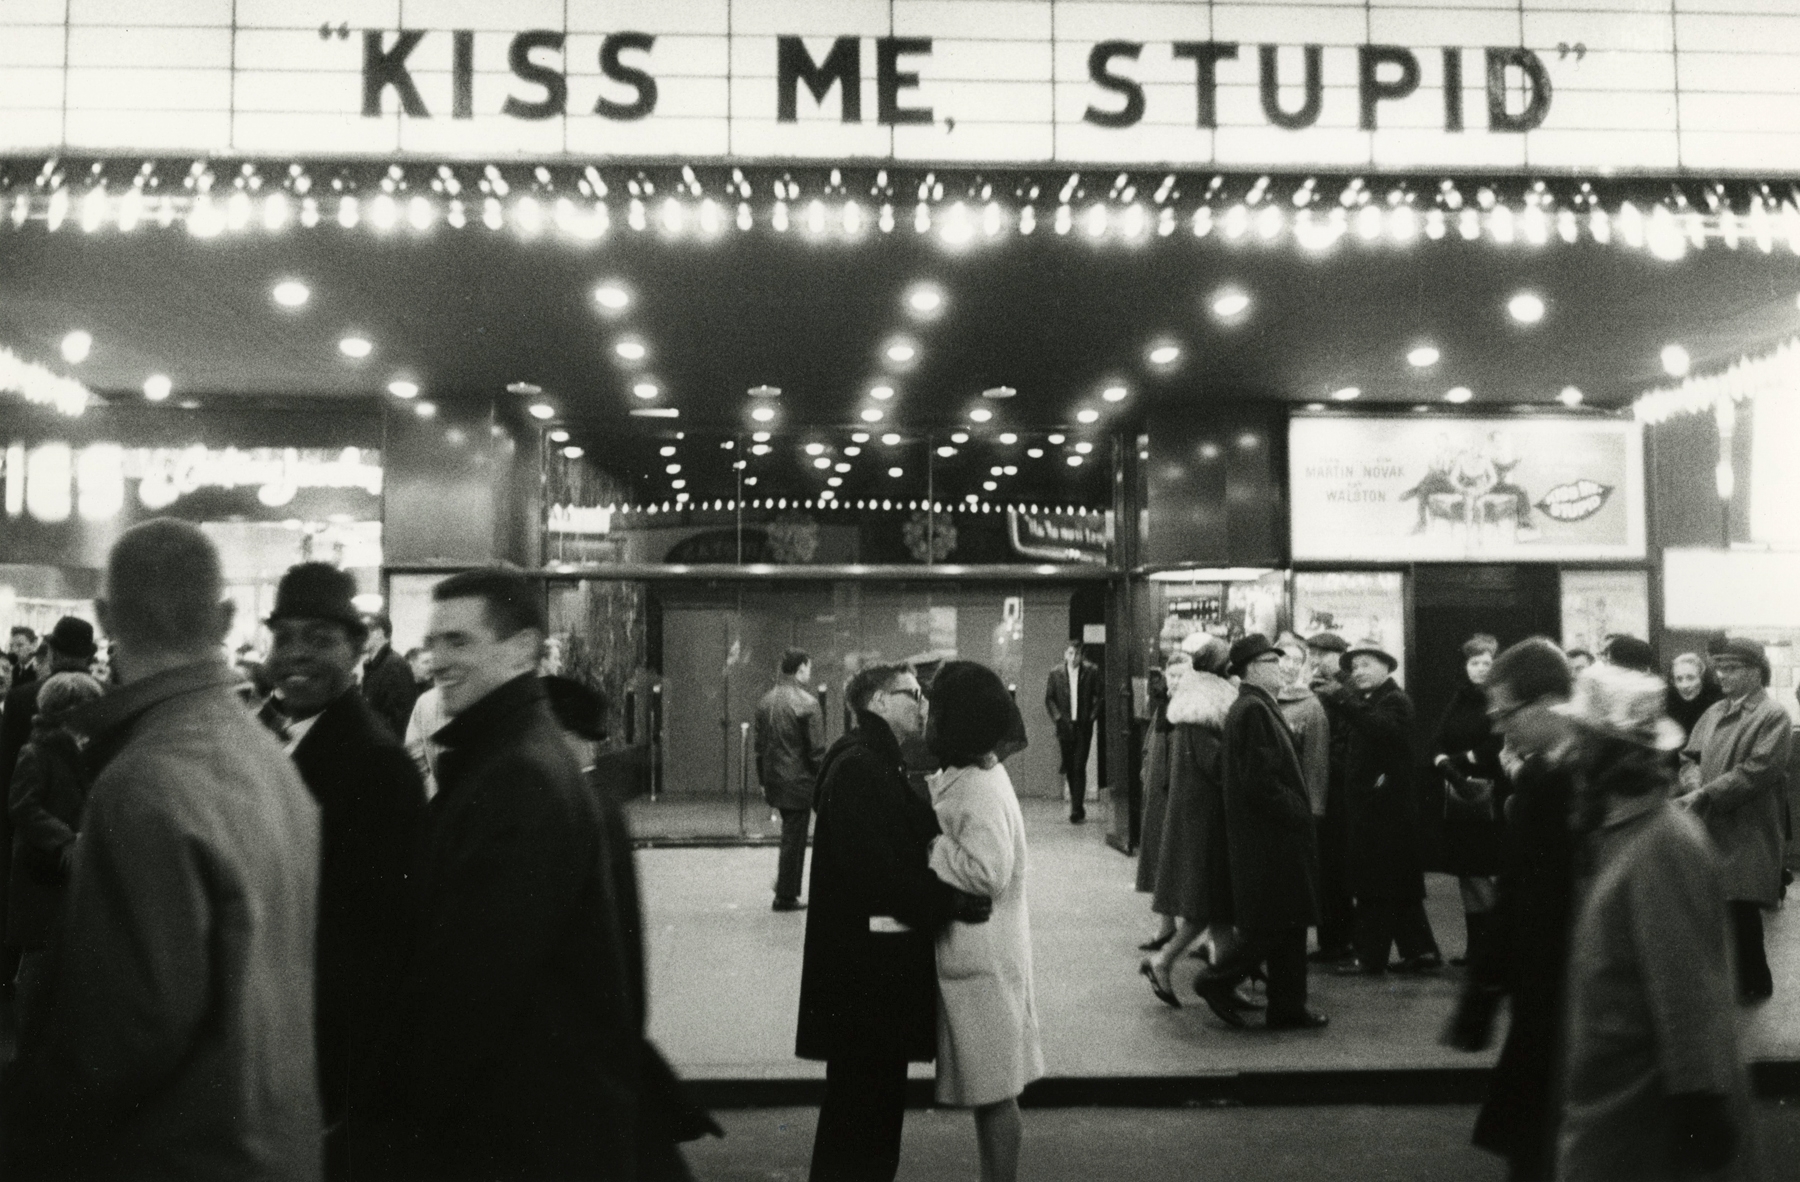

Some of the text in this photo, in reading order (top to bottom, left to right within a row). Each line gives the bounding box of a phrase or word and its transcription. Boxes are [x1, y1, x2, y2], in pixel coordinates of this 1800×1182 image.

[776, 33, 956, 135] ME,
[1305, 465, 1407, 480] MARTIN NOVAK
[1326, 489, 1388, 503] WALSTON
